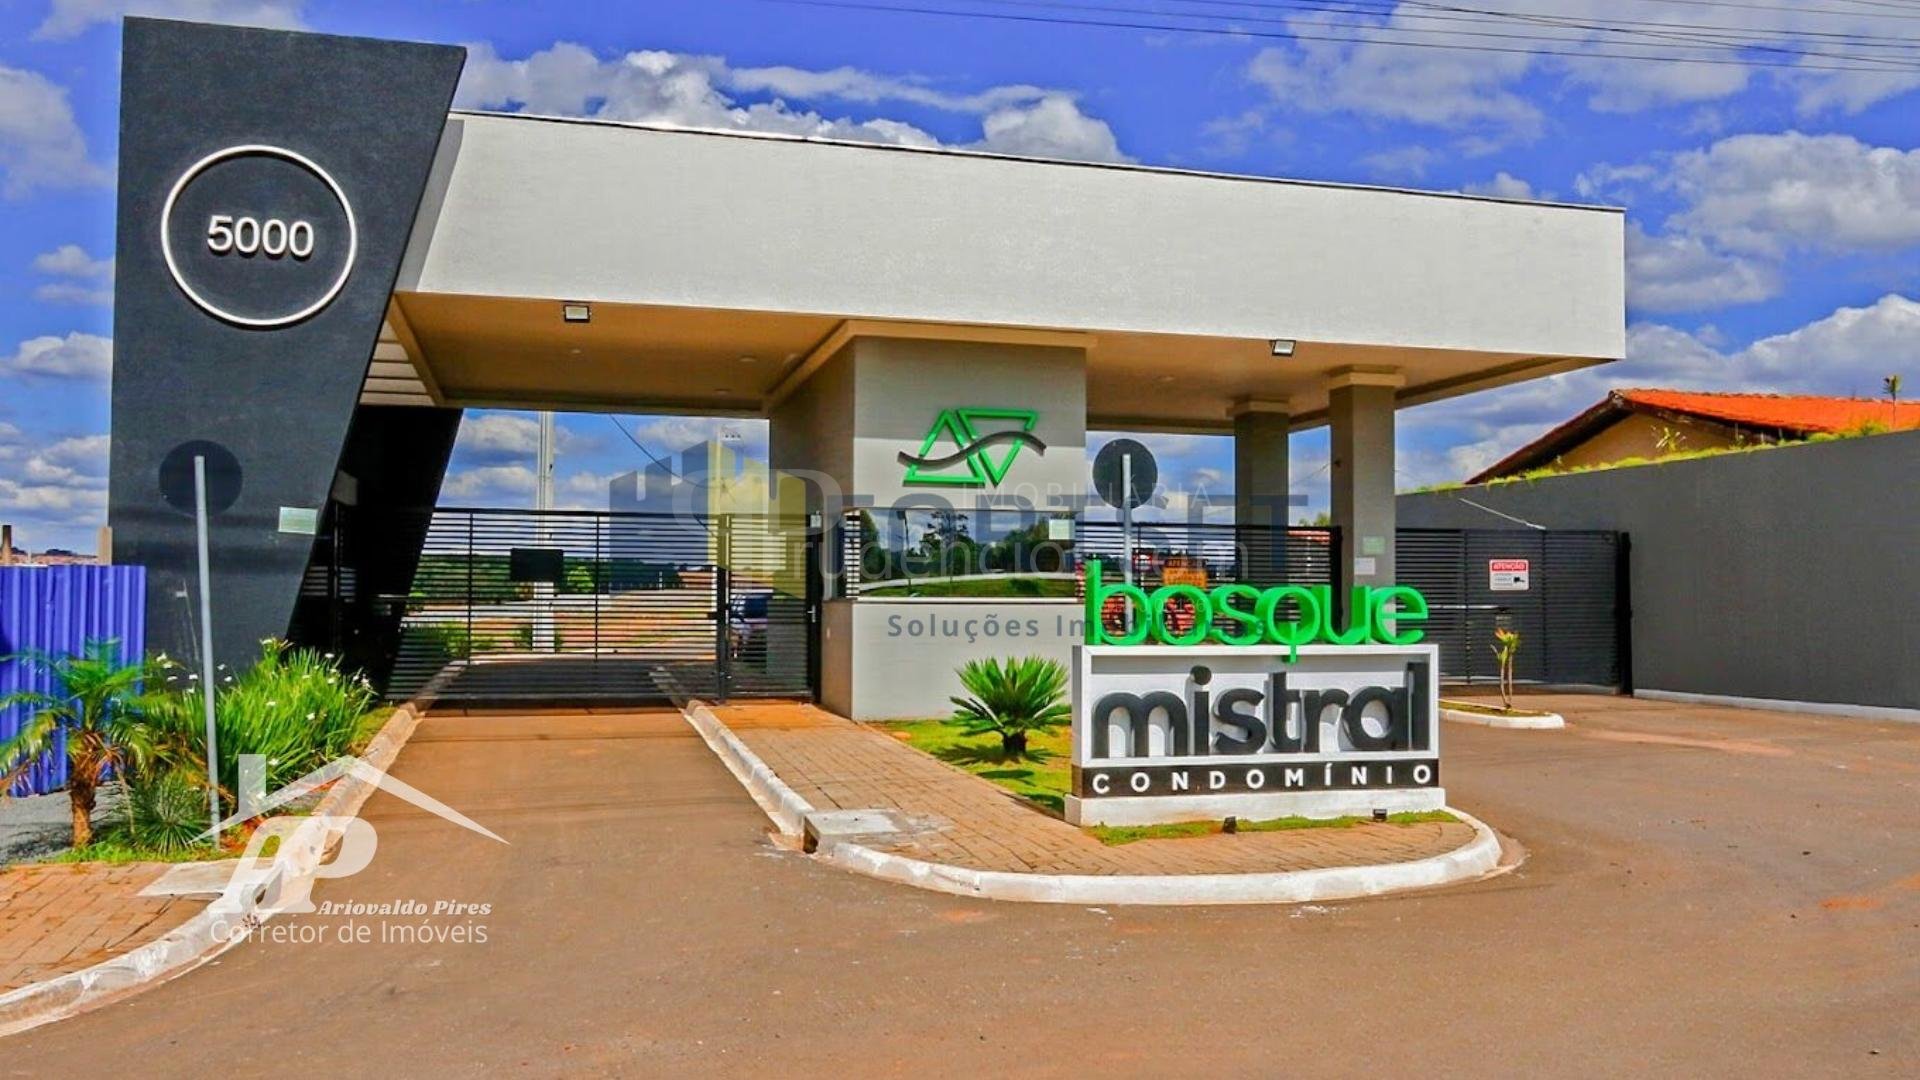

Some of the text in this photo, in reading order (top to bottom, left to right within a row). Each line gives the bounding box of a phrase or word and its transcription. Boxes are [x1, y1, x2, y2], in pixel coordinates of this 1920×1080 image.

[207, 214, 314, 258] 5000
[1084, 558, 1429, 664] bosque
[1092, 662, 1430, 758] mistral
[1092, 763, 1432, 795] CONDOMÍNIO
